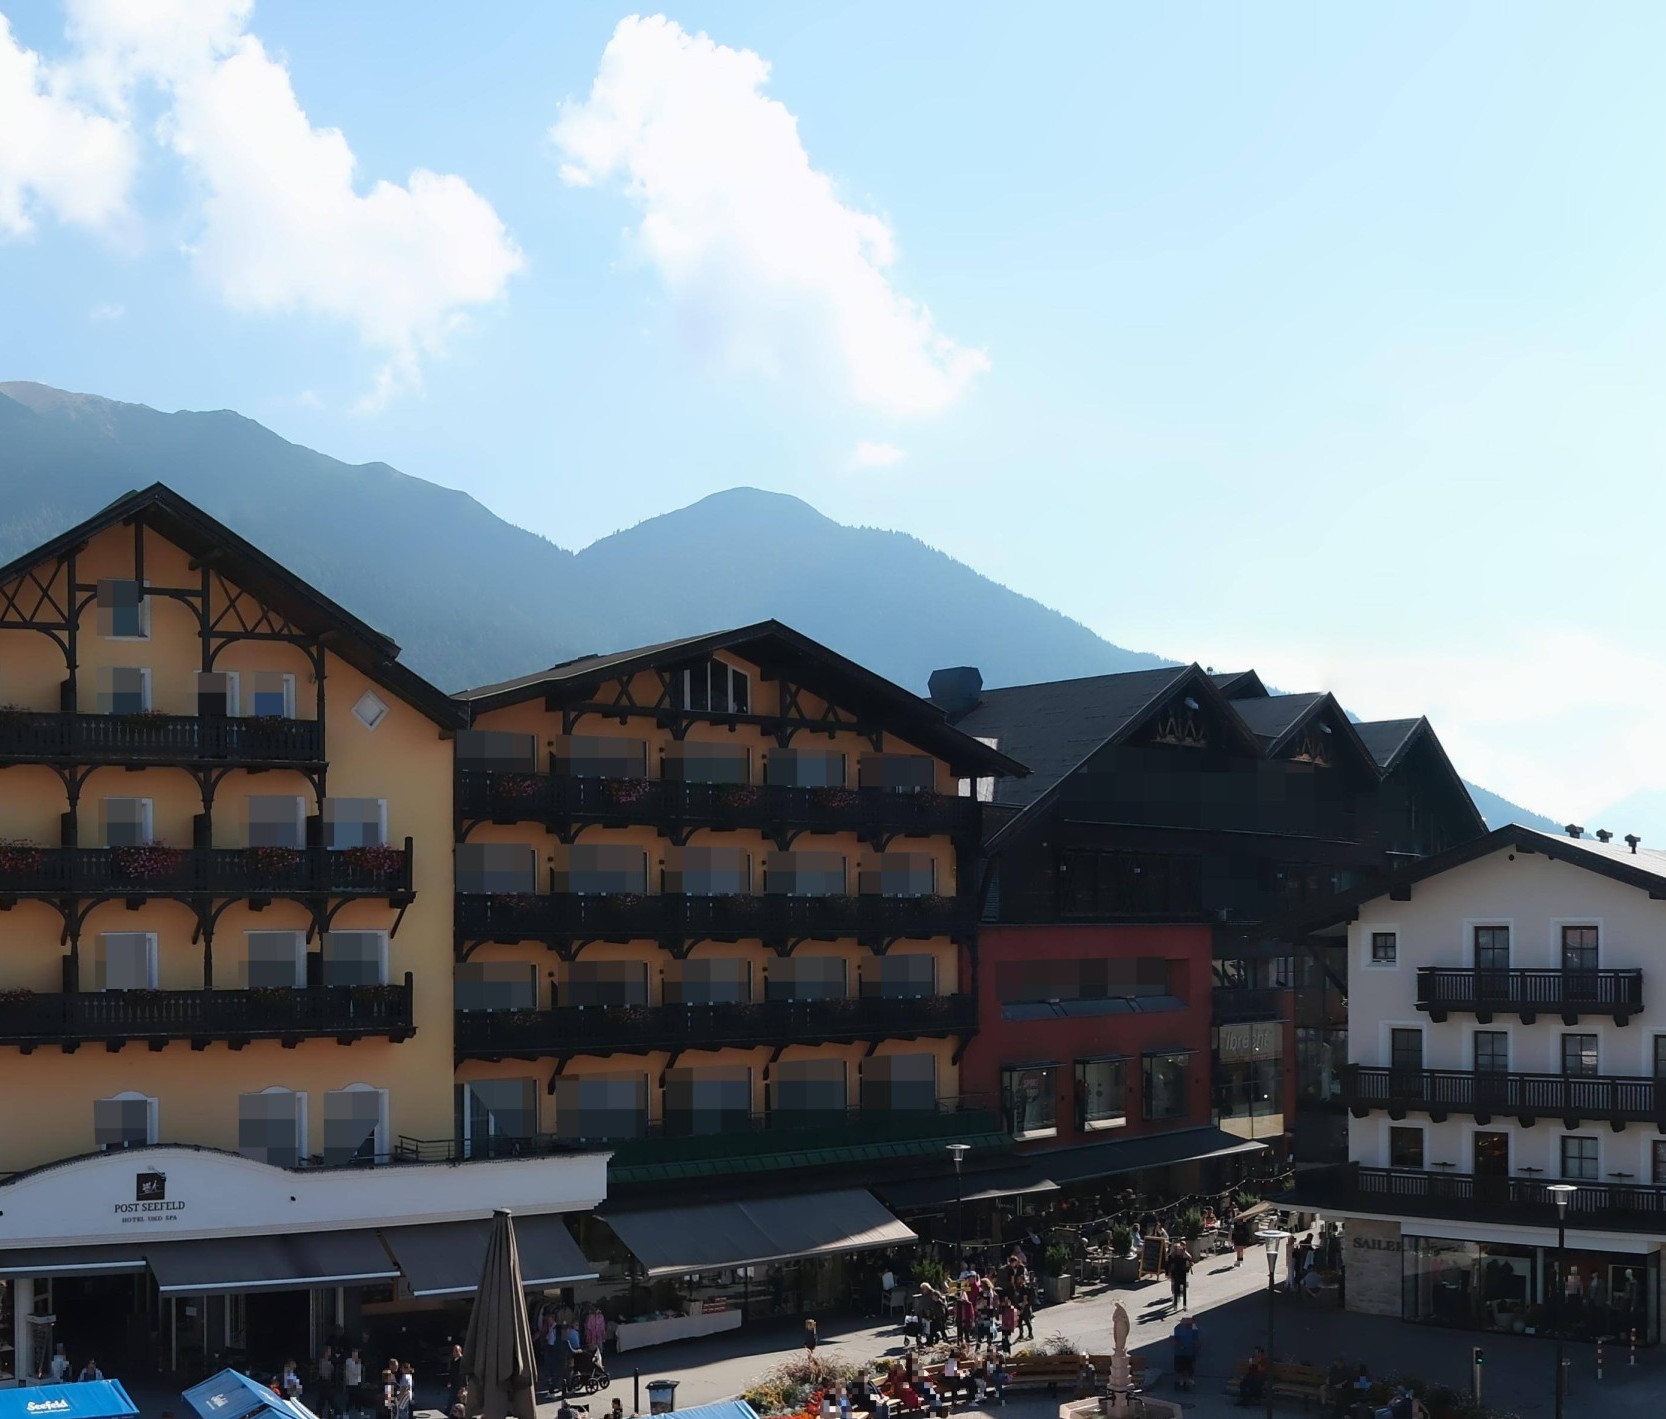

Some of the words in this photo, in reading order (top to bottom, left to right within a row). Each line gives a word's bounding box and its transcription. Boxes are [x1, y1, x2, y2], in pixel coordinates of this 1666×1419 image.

[114, 1203, 139, 1213] POST
[142, 1201, 186, 1212] SEEFELD
[26, 1398, 68, 1413] Seefeld
